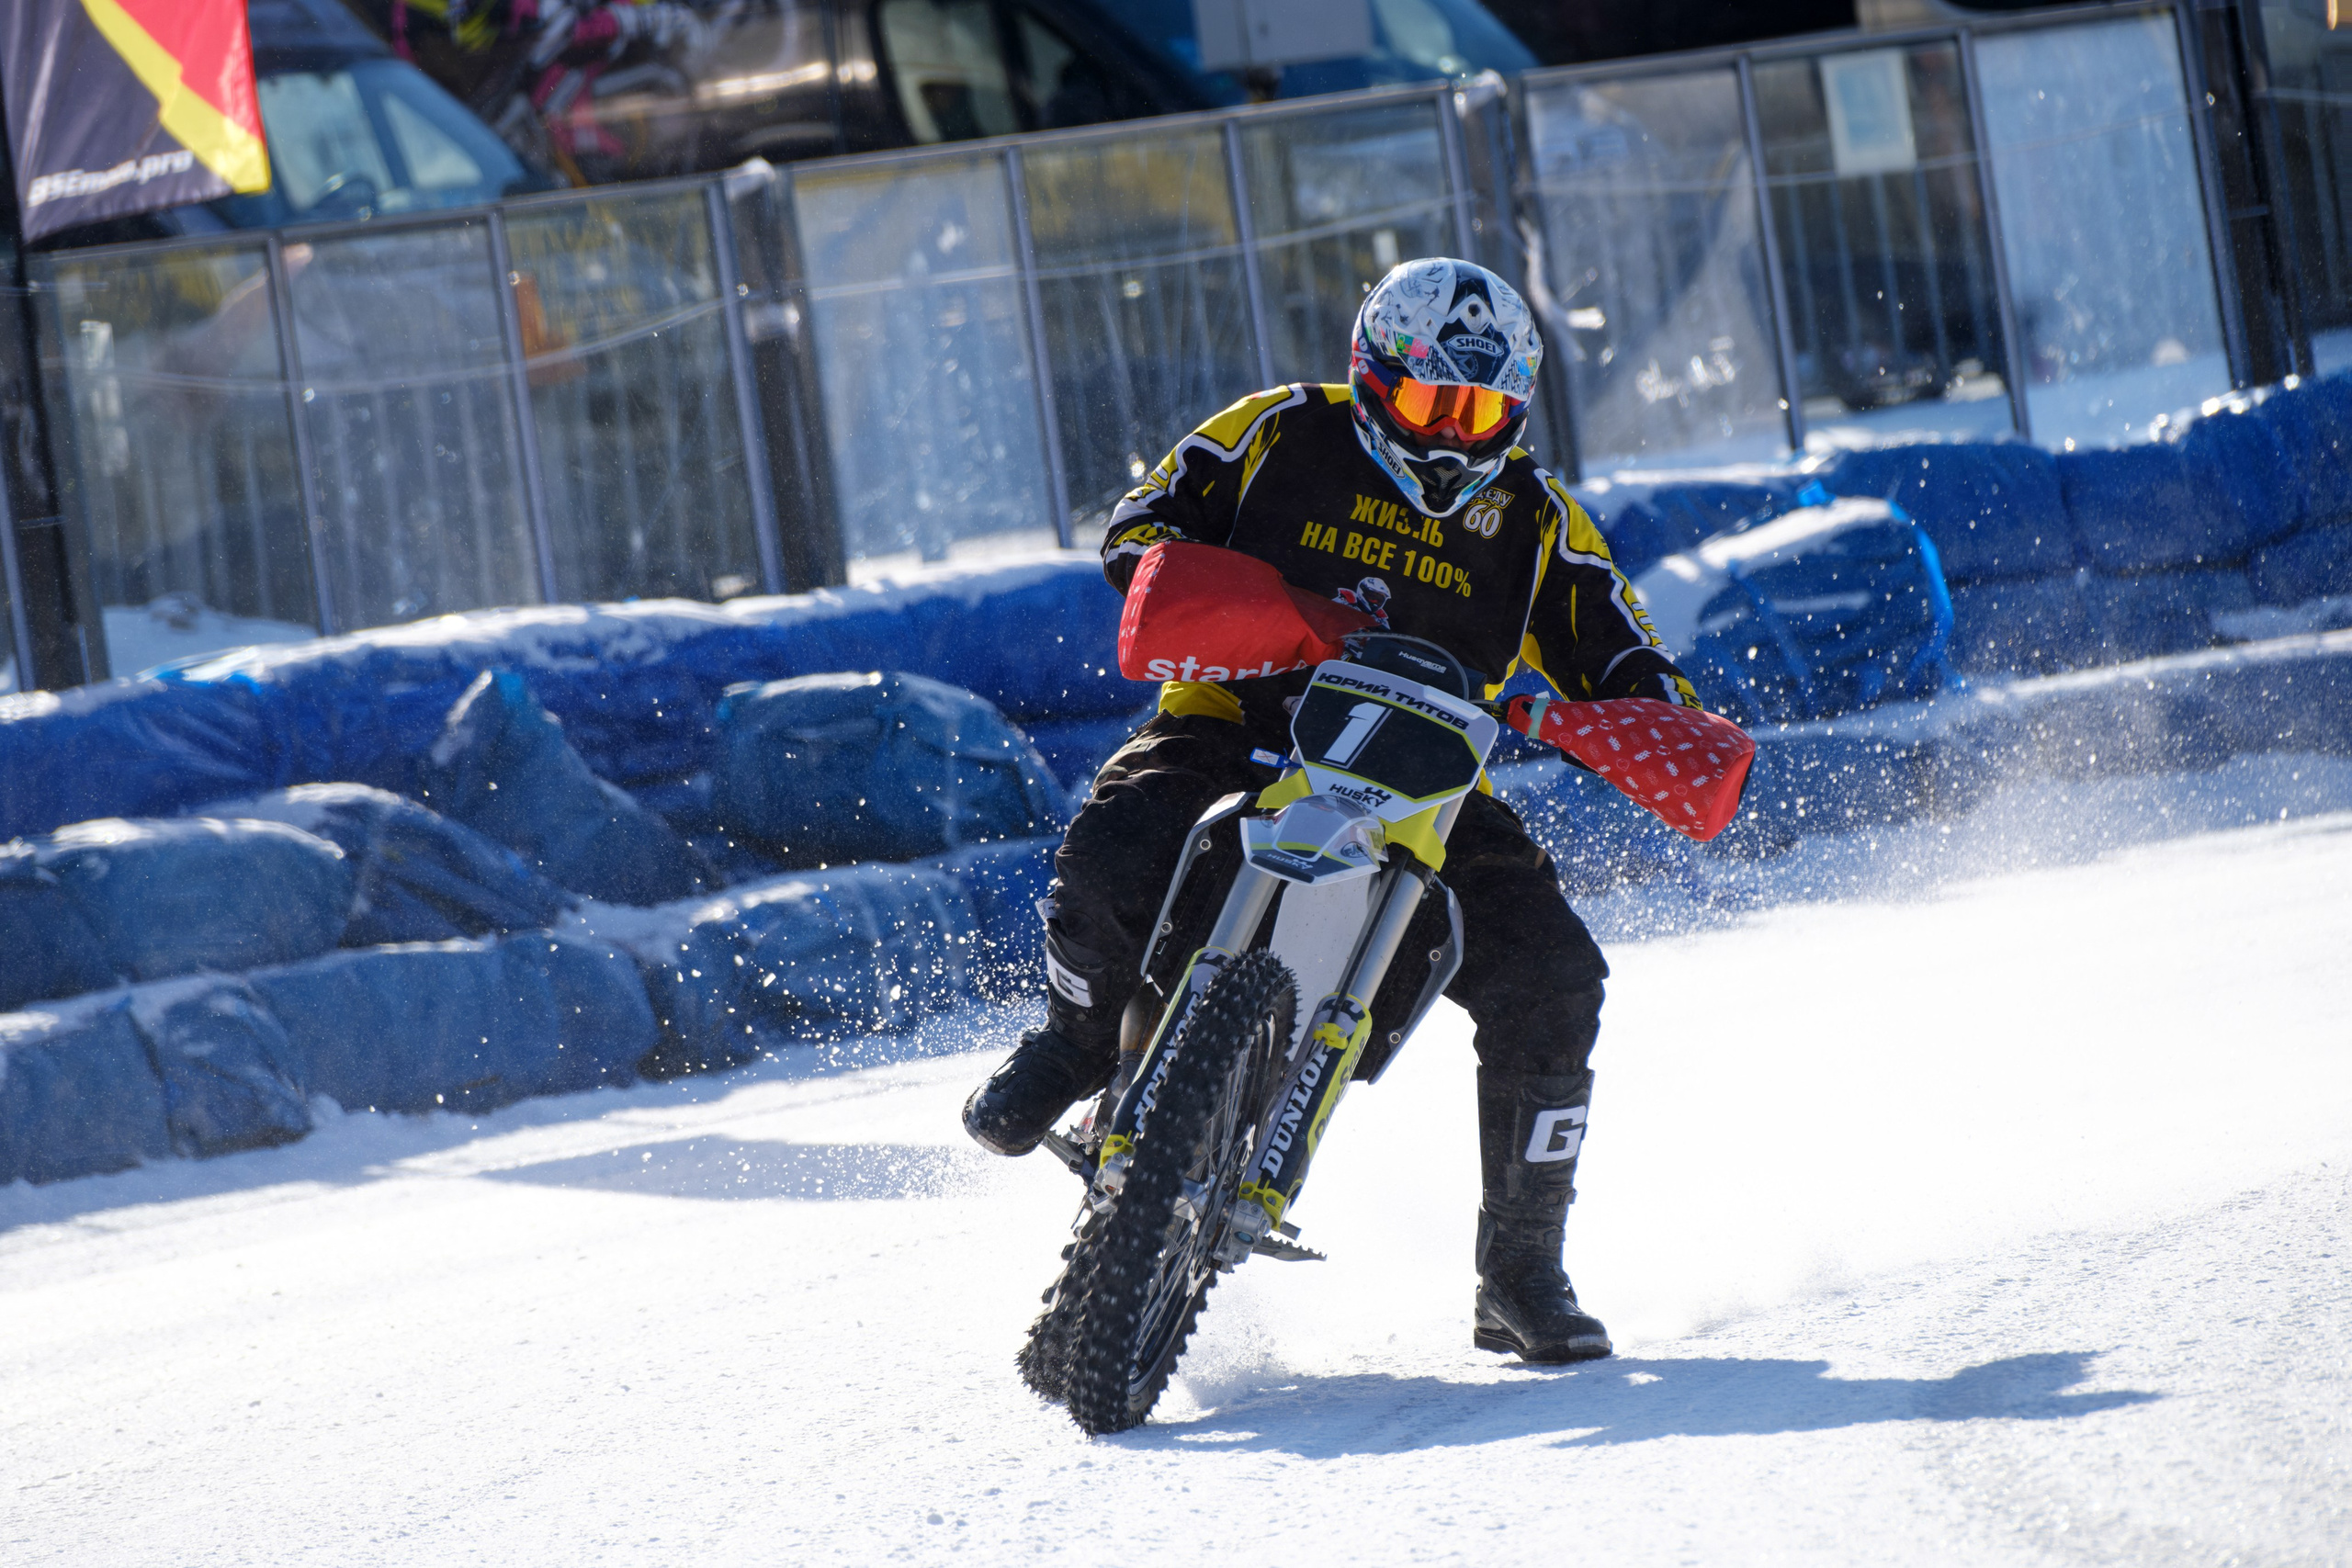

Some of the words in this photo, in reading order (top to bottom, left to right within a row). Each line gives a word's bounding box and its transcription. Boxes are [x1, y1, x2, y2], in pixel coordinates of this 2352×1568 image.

[1455, 337, 1497, 355] SHOEI
[1377, 442, 1402, 475] SHOEI
[1464, 502, 1501, 538] 60
[1299, 521, 1339, 553] НА
[1342, 531, 1397, 571] ВСЕ
[1403, 549, 1472, 598] 100%
[1317, 672, 1391, 697] ЮРИЙ
[1395, 691, 1470, 731] ТИТОВ
[1320, 702, 1394, 770] 1
[1329, 784, 1385, 808] HUSKY
[1524, 1105, 1587, 1163] G
